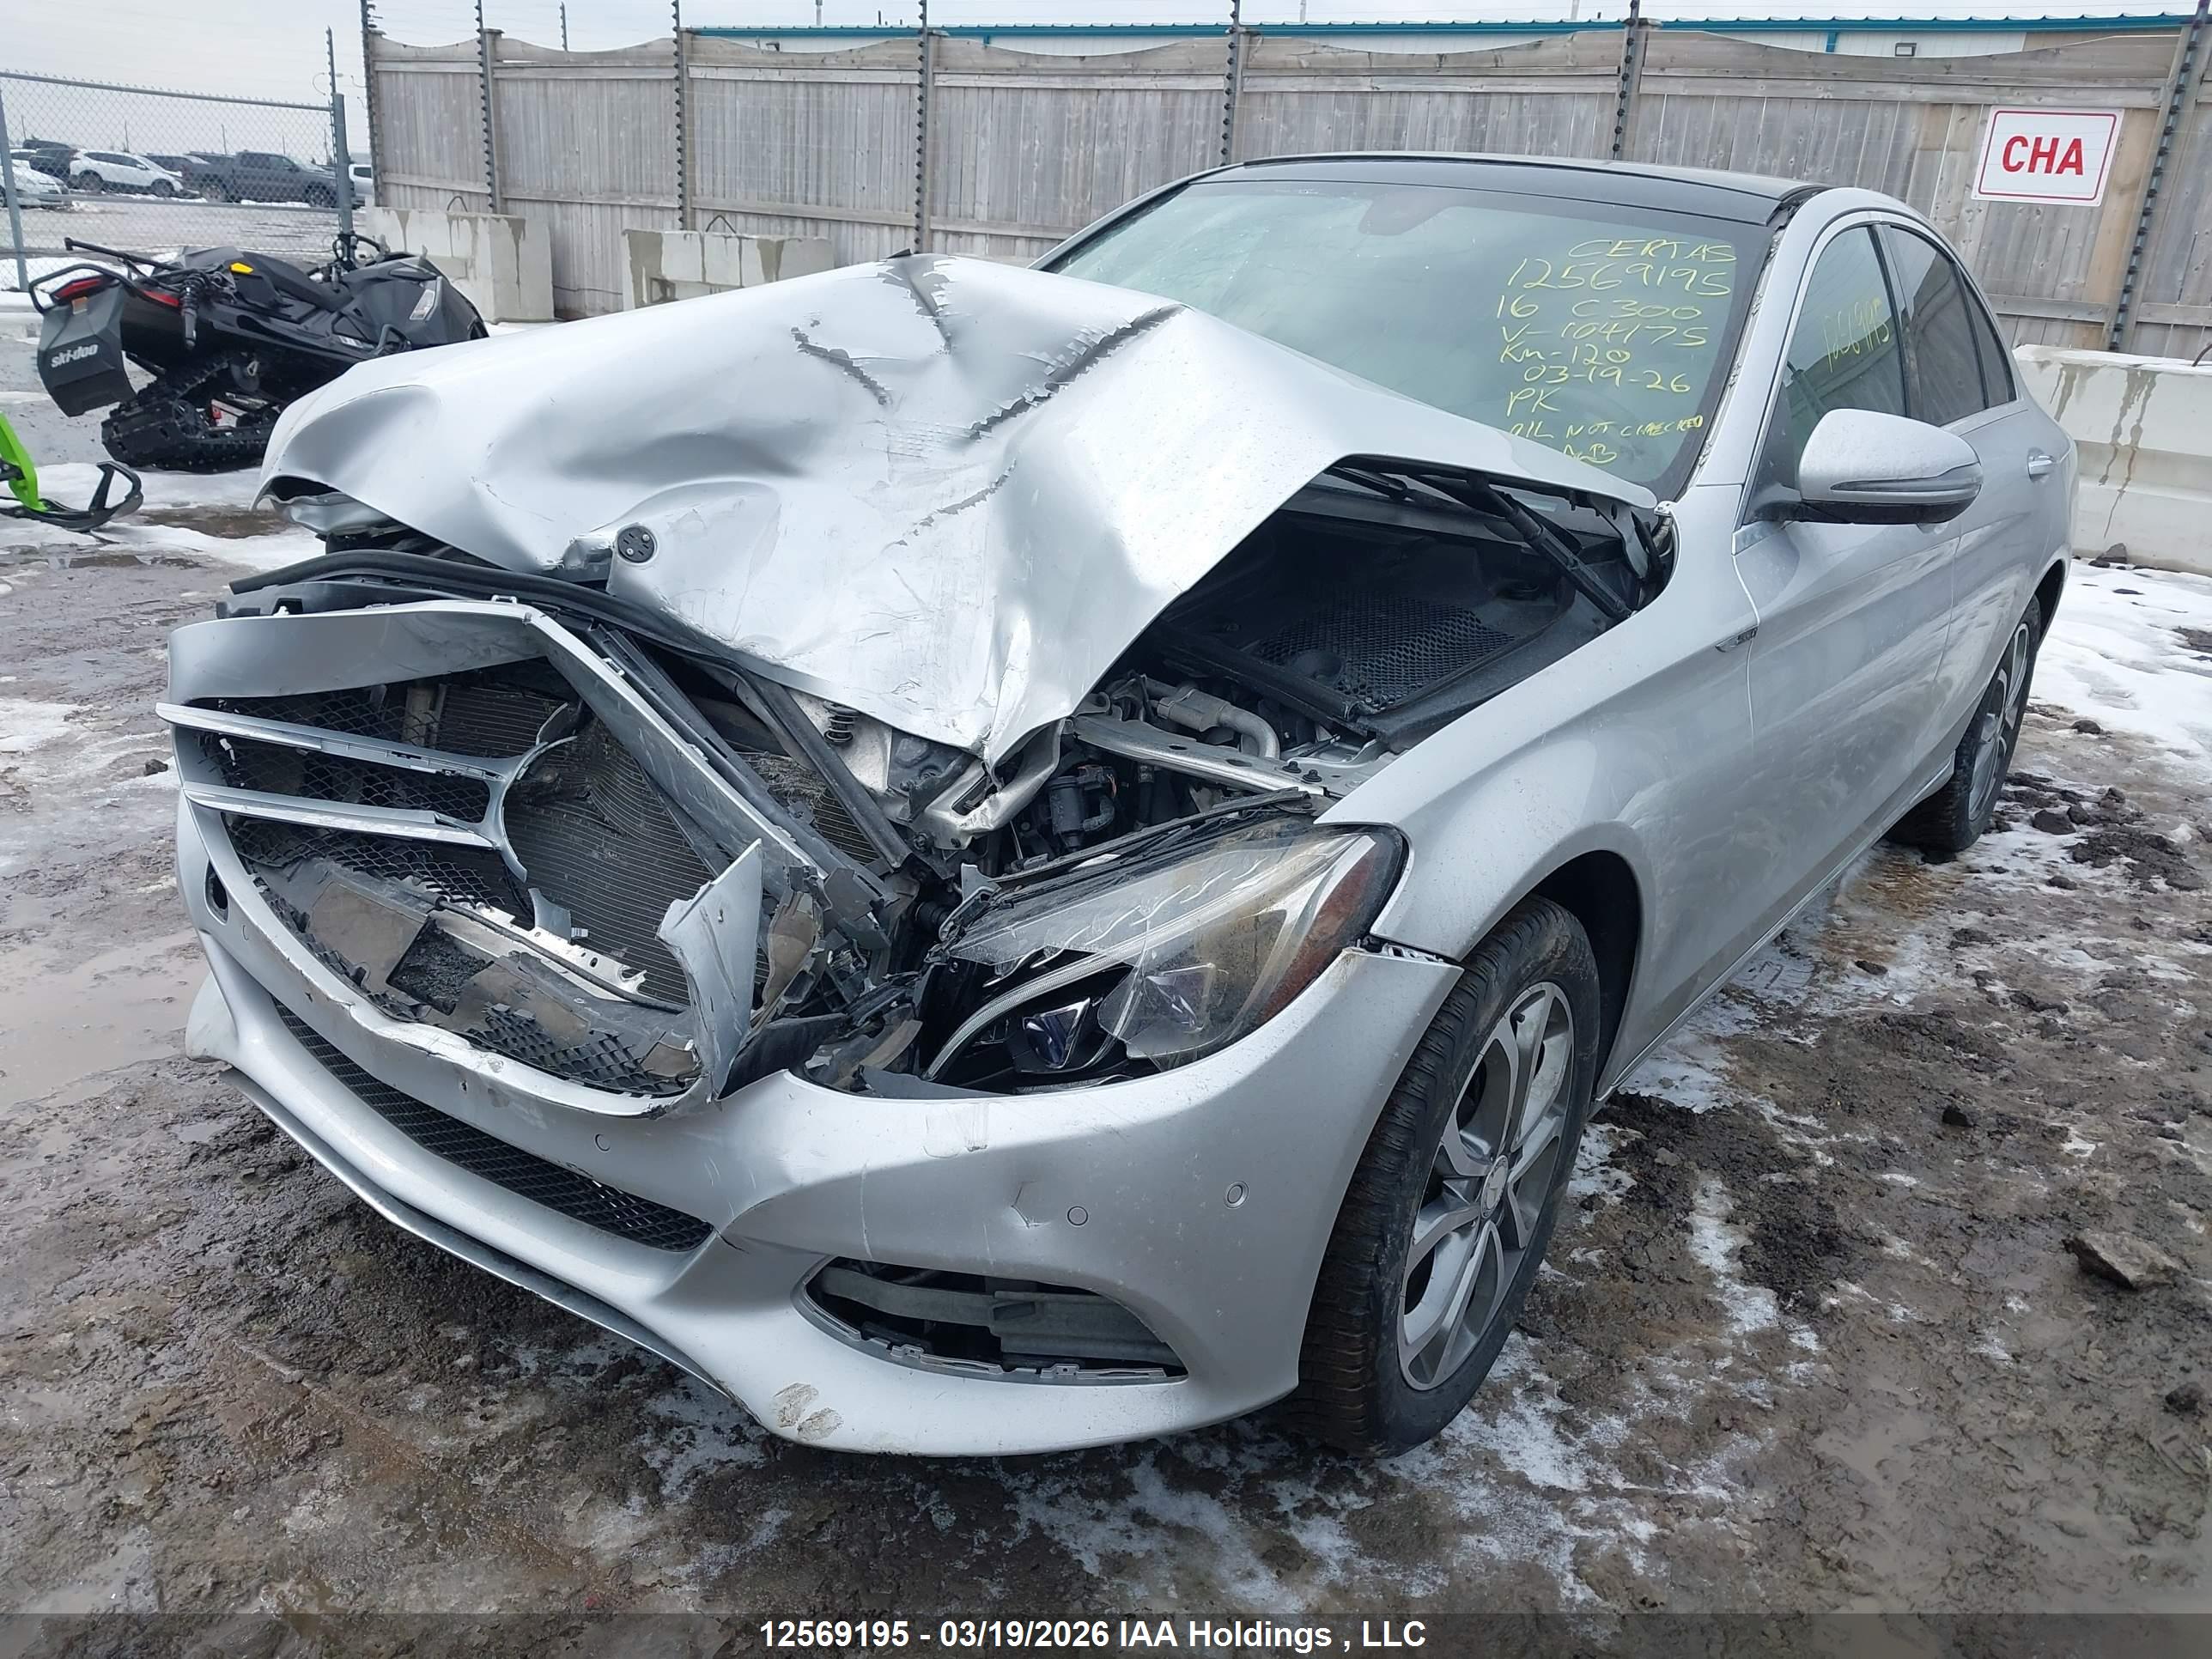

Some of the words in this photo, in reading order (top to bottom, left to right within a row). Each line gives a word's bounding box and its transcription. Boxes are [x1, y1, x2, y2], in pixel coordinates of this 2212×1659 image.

[2002, 136, 2083, 175] CHA
[1569, 240, 1736, 262] CERTAS
[1507, 258, 1730, 295] 12569195
[1497, 295, 1539, 318] 16
[1566, 422, 1616, 439] NOT
